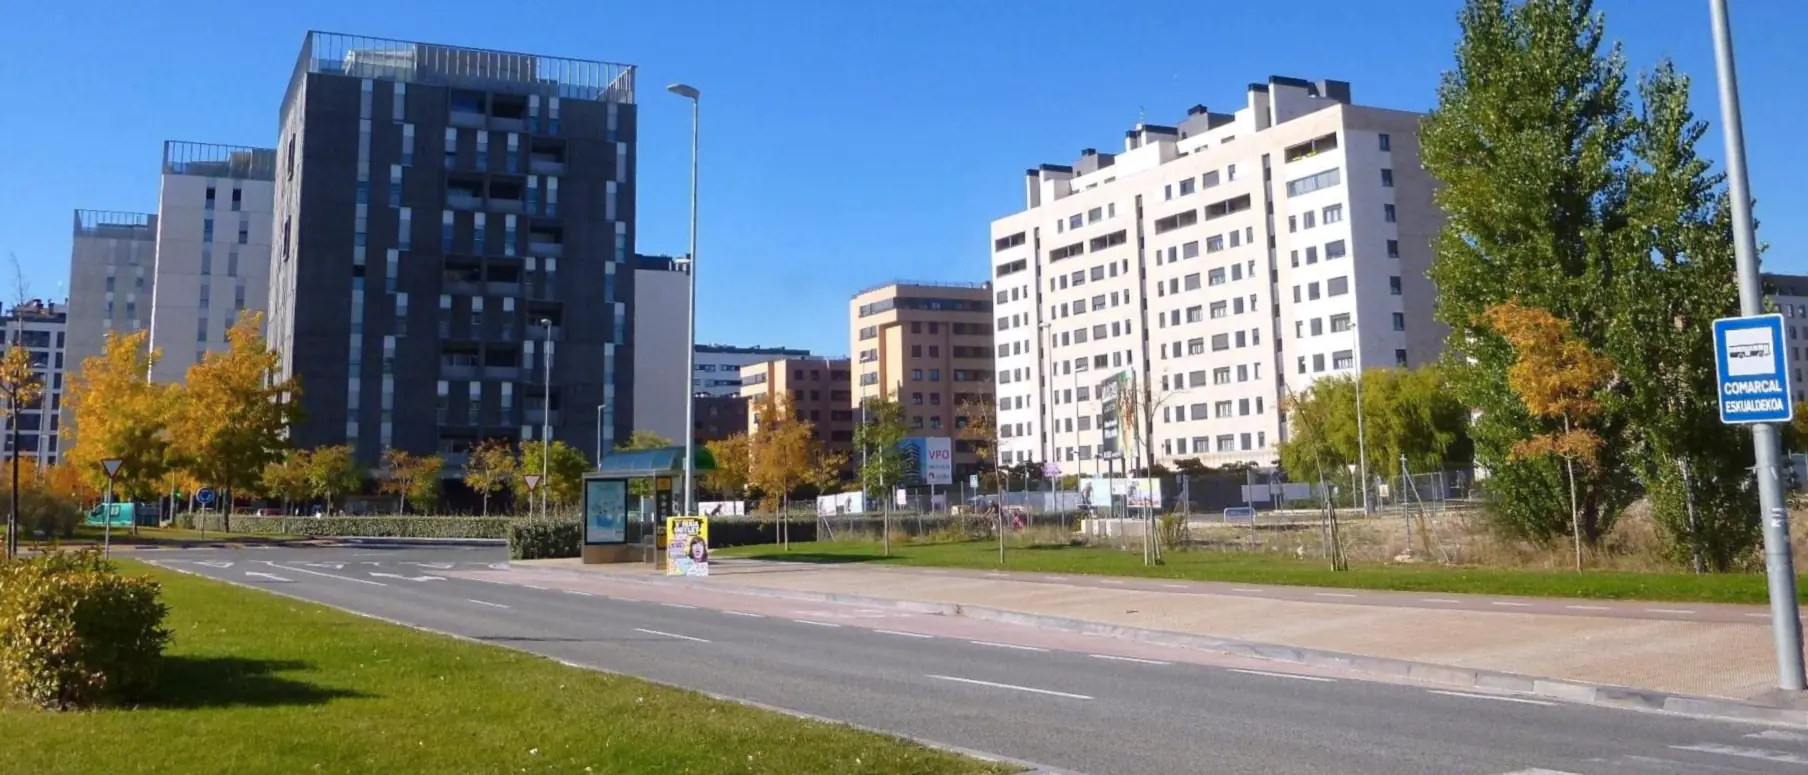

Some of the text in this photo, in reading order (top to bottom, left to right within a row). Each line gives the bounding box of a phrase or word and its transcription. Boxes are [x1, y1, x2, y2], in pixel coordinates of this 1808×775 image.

[1724, 380, 1783, 395] COMARCAL
[1725, 398, 1784, 413] ESKUALDEKOA
[928, 449, 950, 460] VPO
